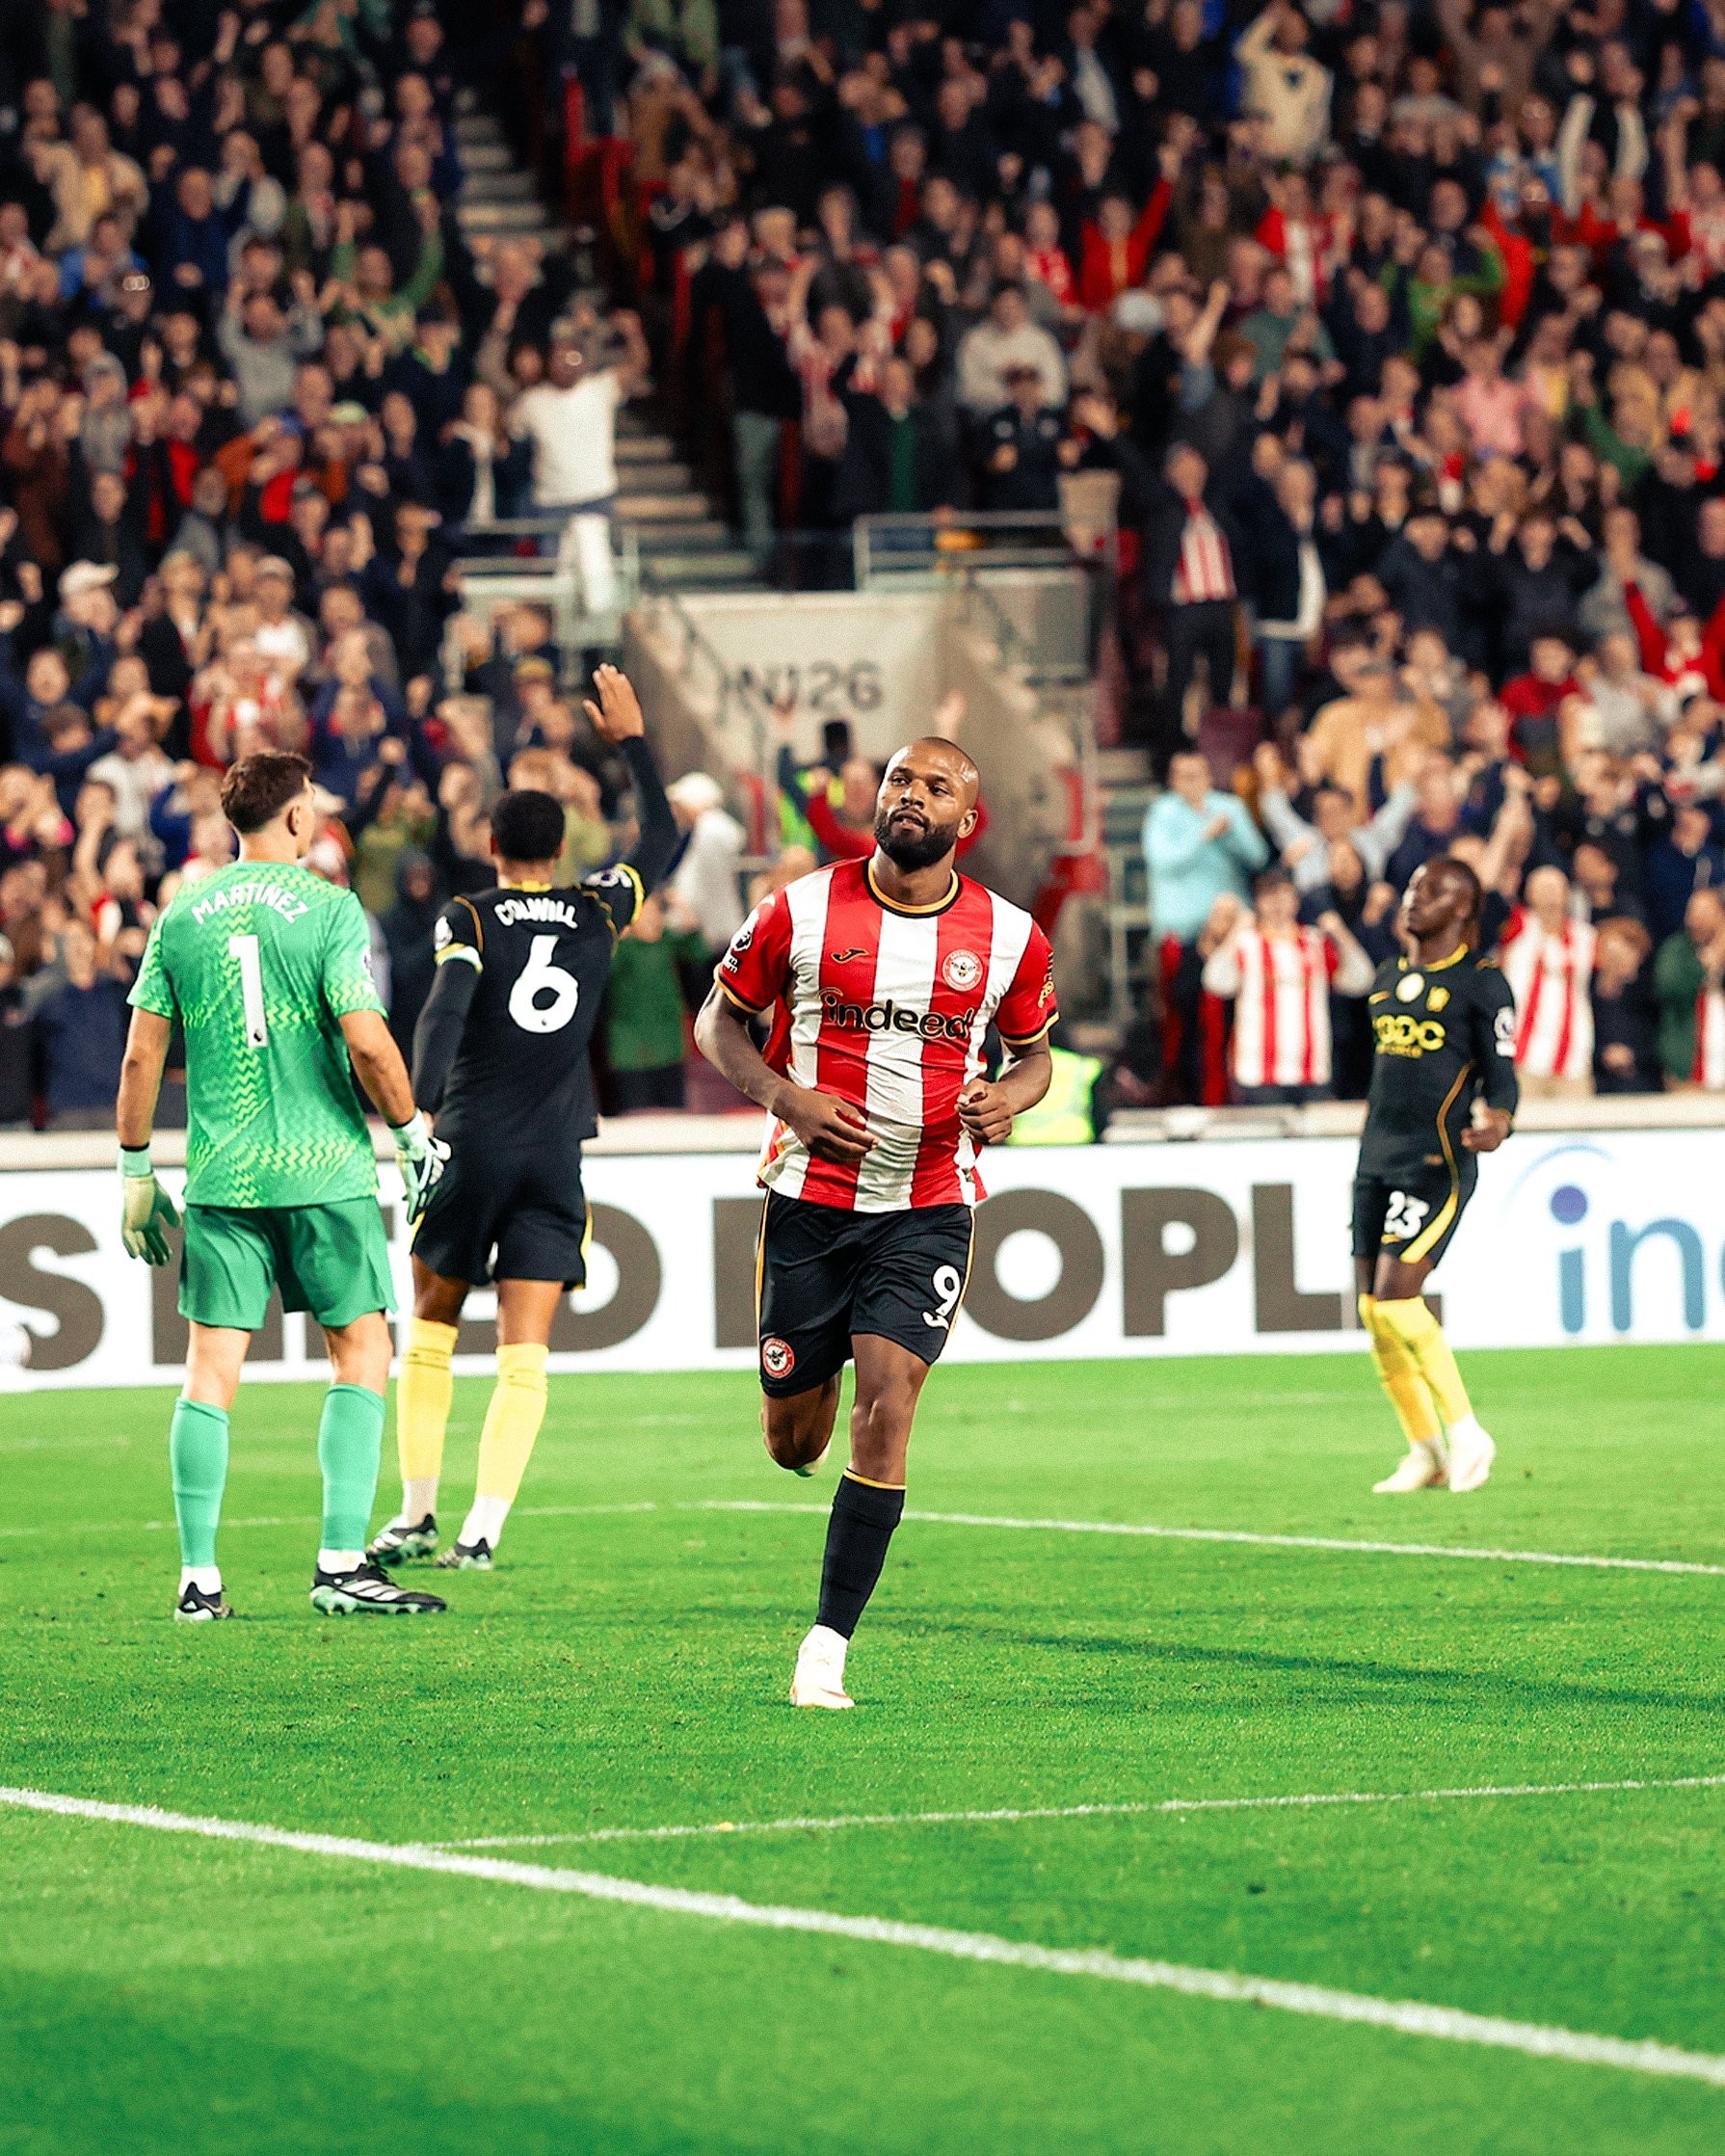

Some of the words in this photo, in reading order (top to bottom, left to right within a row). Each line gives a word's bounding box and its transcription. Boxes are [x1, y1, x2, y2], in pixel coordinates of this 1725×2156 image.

[192, 883, 309, 925] MARTINEZ
[227, 934, 268, 1048] 1
[508, 934, 578, 1034] 6
[819, 997, 974, 1040] indeed
[1384, 1190, 1430, 1239] 23
[1550, 1184, 1725, 1334] in
[922, 1264, 962, 1332] 9
